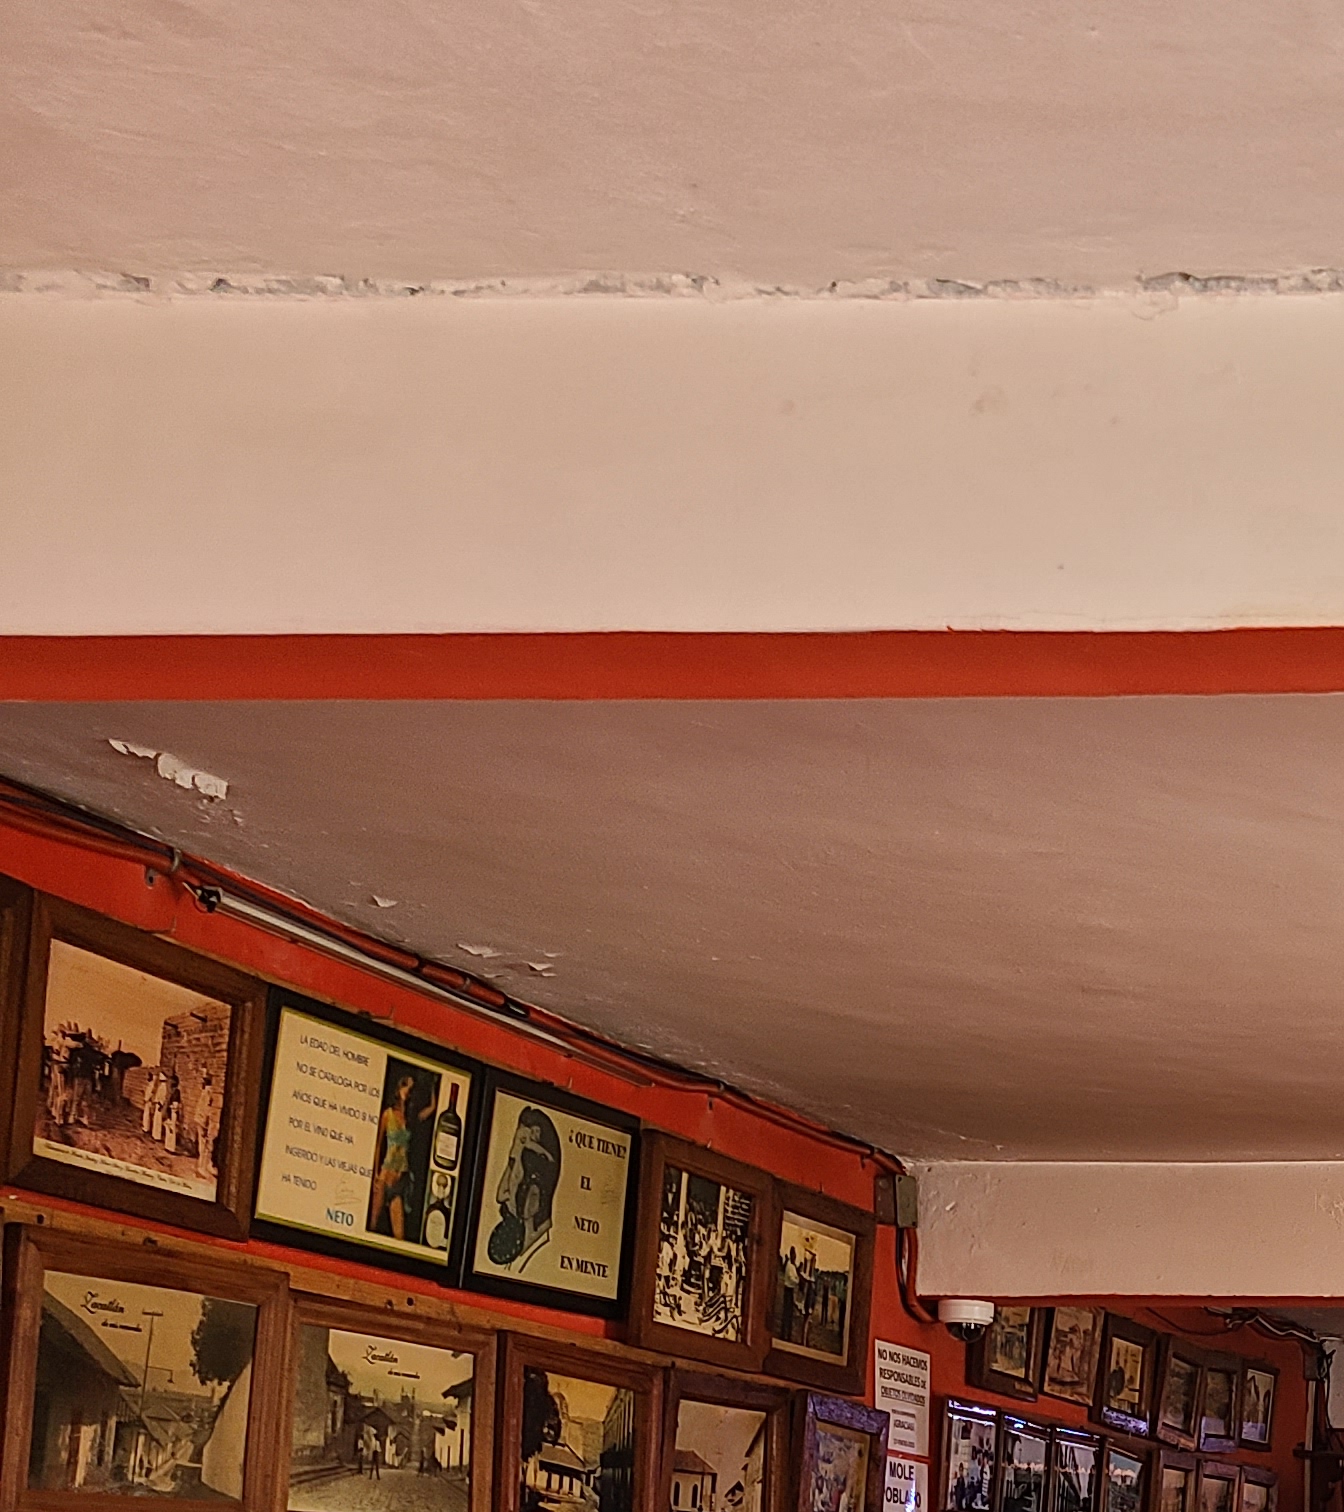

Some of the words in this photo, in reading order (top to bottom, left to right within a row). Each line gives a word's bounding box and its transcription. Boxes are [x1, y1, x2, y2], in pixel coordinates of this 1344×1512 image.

[296, 1061, 308, 1074] NO
[309, 1066, 317, 1077] SE
[313, 1096, 327, 1109] QUE
[288, 1117, 303, 1129] POR
[329, 1130, 343, 1142] QUE
[575, 1132, 595, 1150] QUE
[597, 1137, 627, 1159] TIENE?
[580, 1175, 592, 1191] EL
[326, 1207, 354, 1226] NETO
[574, 1216, 600, 1234] NETO
[560, 1255, 574, 1271] EN
[575, 1258, 609, 1278] MENTE
[877, 1347, 888, 1361] NO
[889, 1349, 901, 1364] NOS
[901, 1354, 928, 1372] HACEMOS
[889, 1461, 914, 1480] MOLE
[885, 1486, 921, 1508] OBLAO
